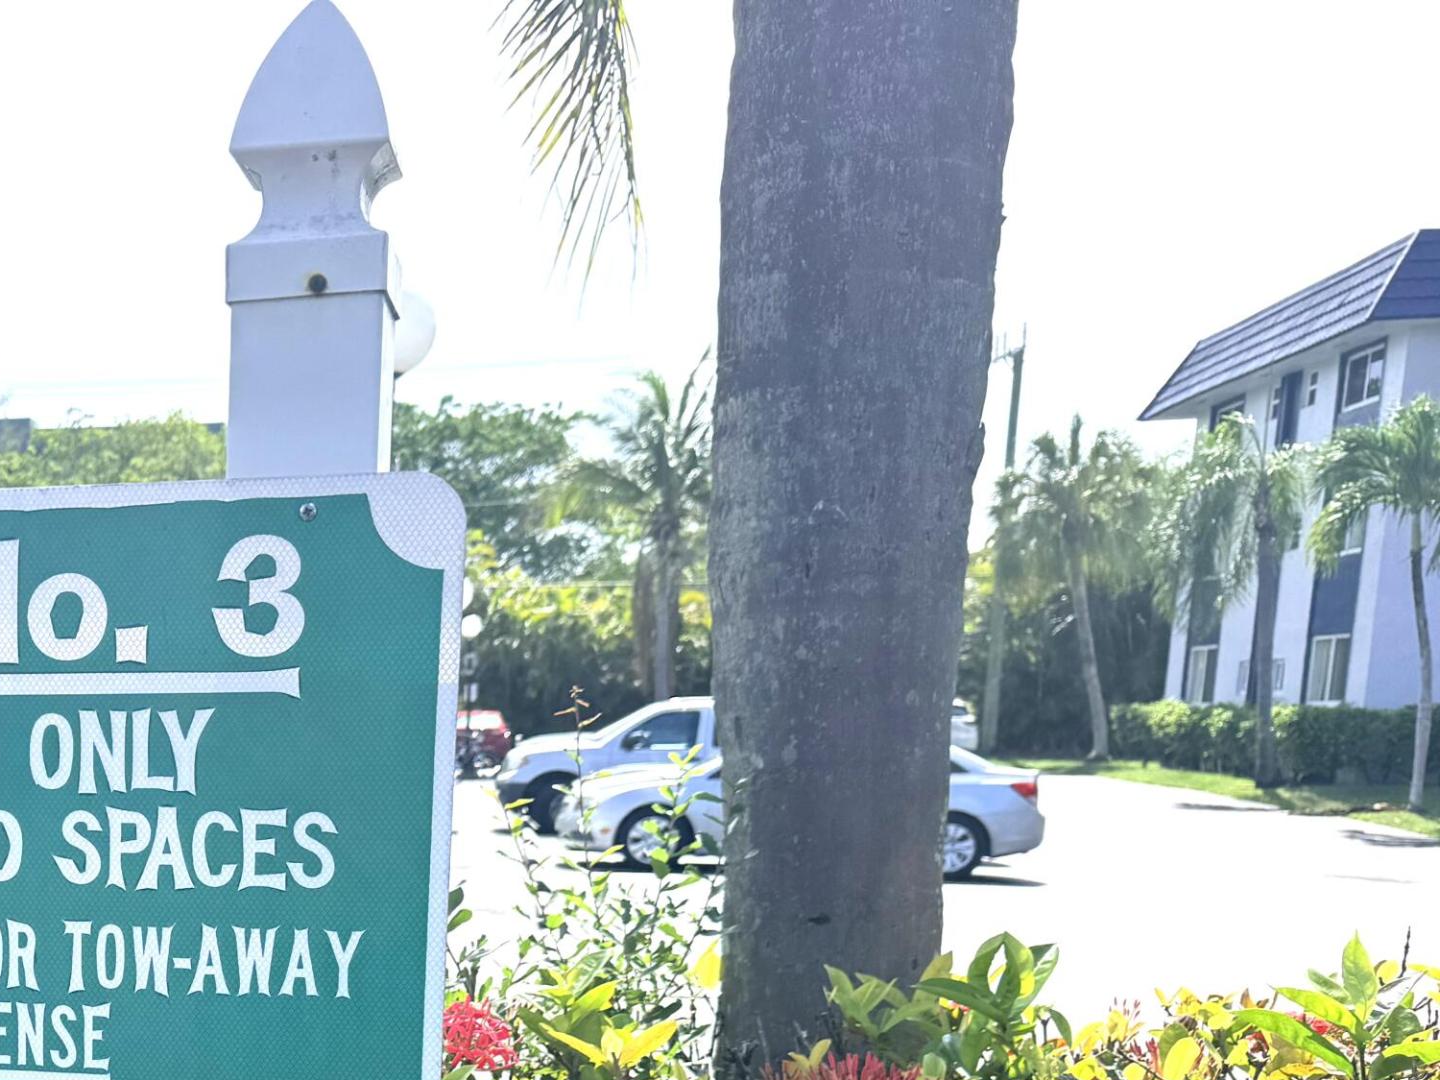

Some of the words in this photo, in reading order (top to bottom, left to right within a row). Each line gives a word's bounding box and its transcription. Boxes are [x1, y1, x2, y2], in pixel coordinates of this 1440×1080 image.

[212, 534, 305, 657] 3
[30, 708, 215, 795] ONLY
[53, 806, 338, 891] SPACES
[63, 921, 365, 998] TOW-AWAY
